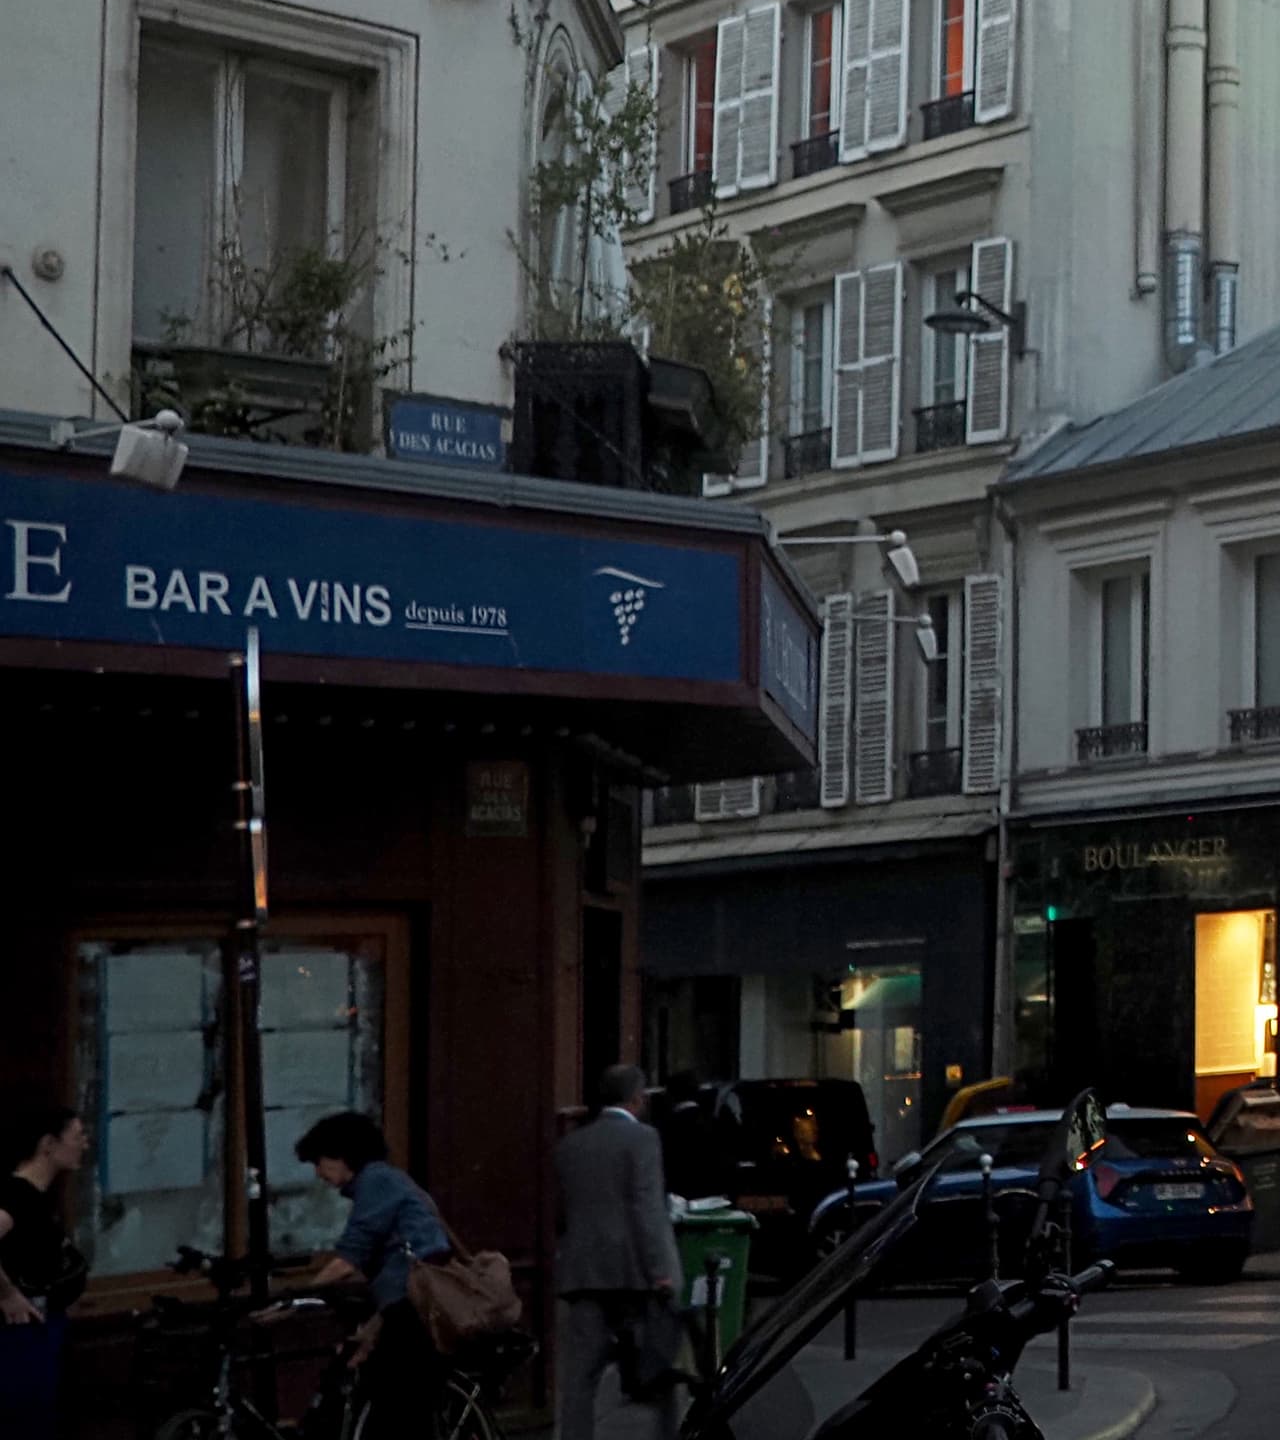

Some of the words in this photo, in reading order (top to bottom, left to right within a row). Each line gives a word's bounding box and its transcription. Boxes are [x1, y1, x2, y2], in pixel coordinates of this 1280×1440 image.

[432, 412, 467, 433] RUE
[399, 431, 431, 451] DES
[435, 436, 497, 460] ACACIAS
[4, 518, 73, 604] E
[125, 563, 232, 616] BAR
[243, 575, 279, 619] A
[287, 578, 393, 627] VINS
[404, 600, 465, 624] depuis
[470, 605, 508, 627] 1978
[1084, 836, 1227, 872] BOULANGER
